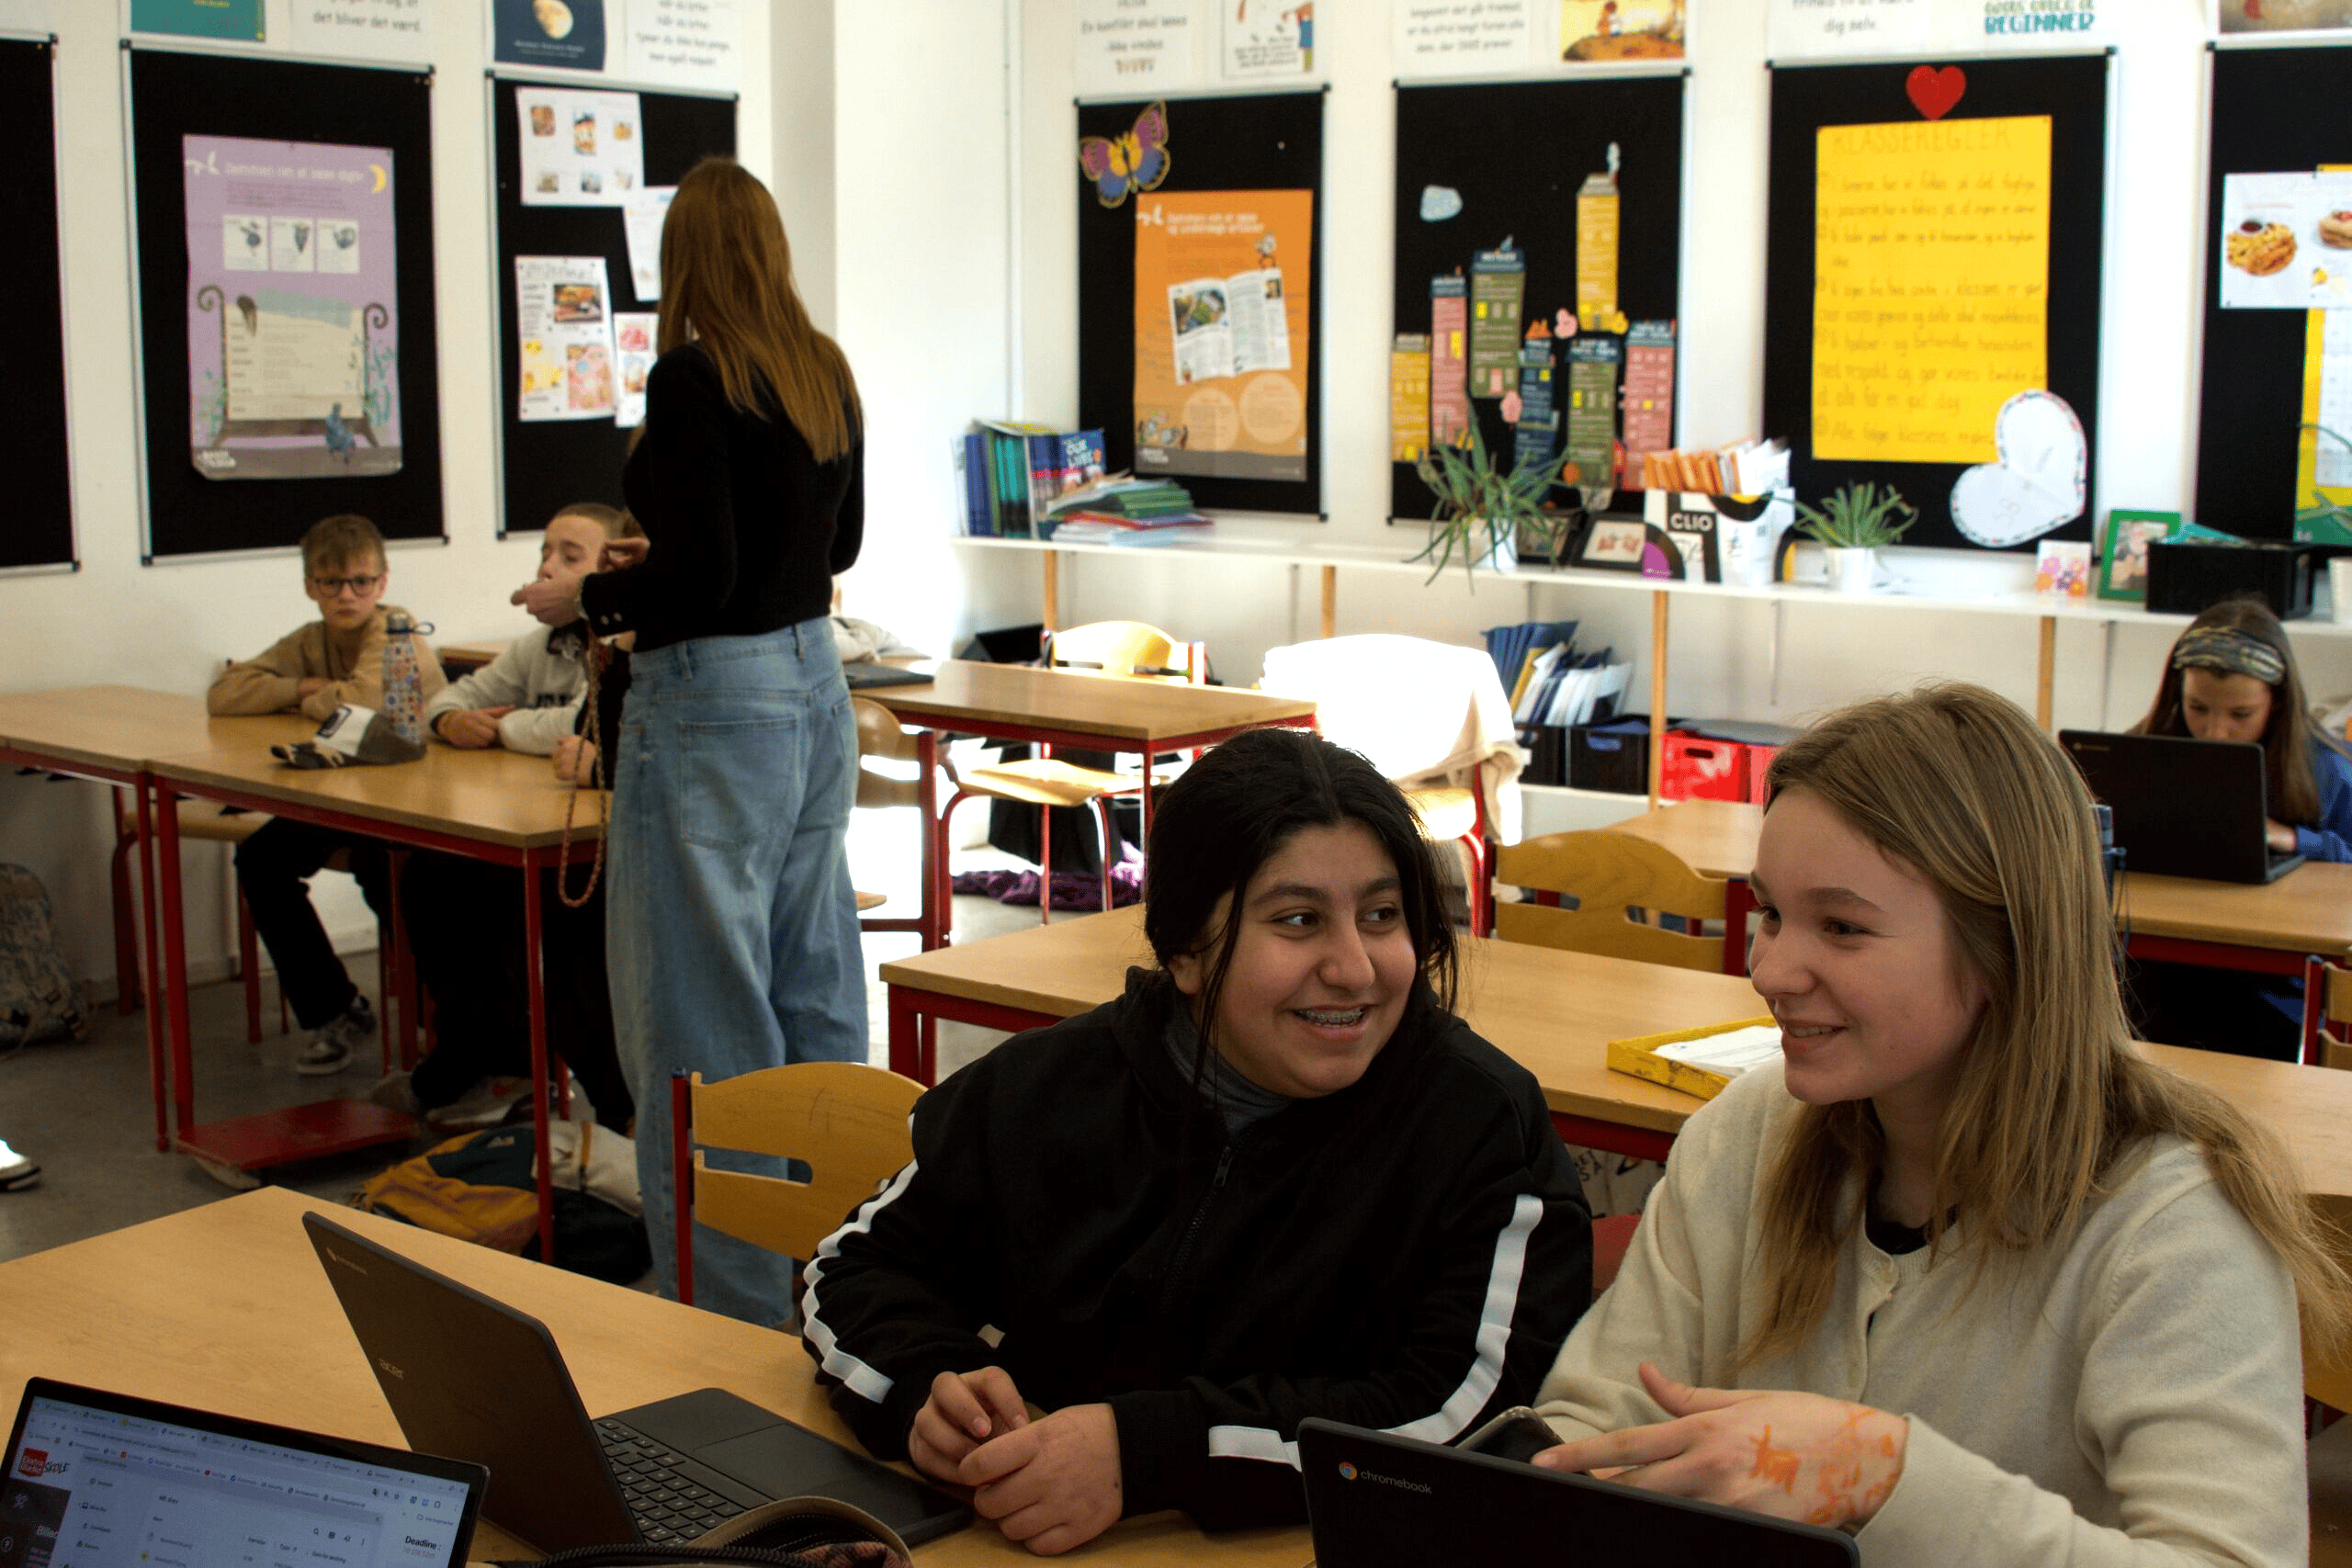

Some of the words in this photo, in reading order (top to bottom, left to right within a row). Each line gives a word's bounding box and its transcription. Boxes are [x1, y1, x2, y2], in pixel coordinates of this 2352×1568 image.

[1984, 12, 2096, 35] BEGINNER
[1669, 512, 1714, 533] CLIO
[378, 1357, 405, 1381] acer
[1360, 1469, 1433, 1496] chromebook
[404, 1535, 437, 1550] Deadline
